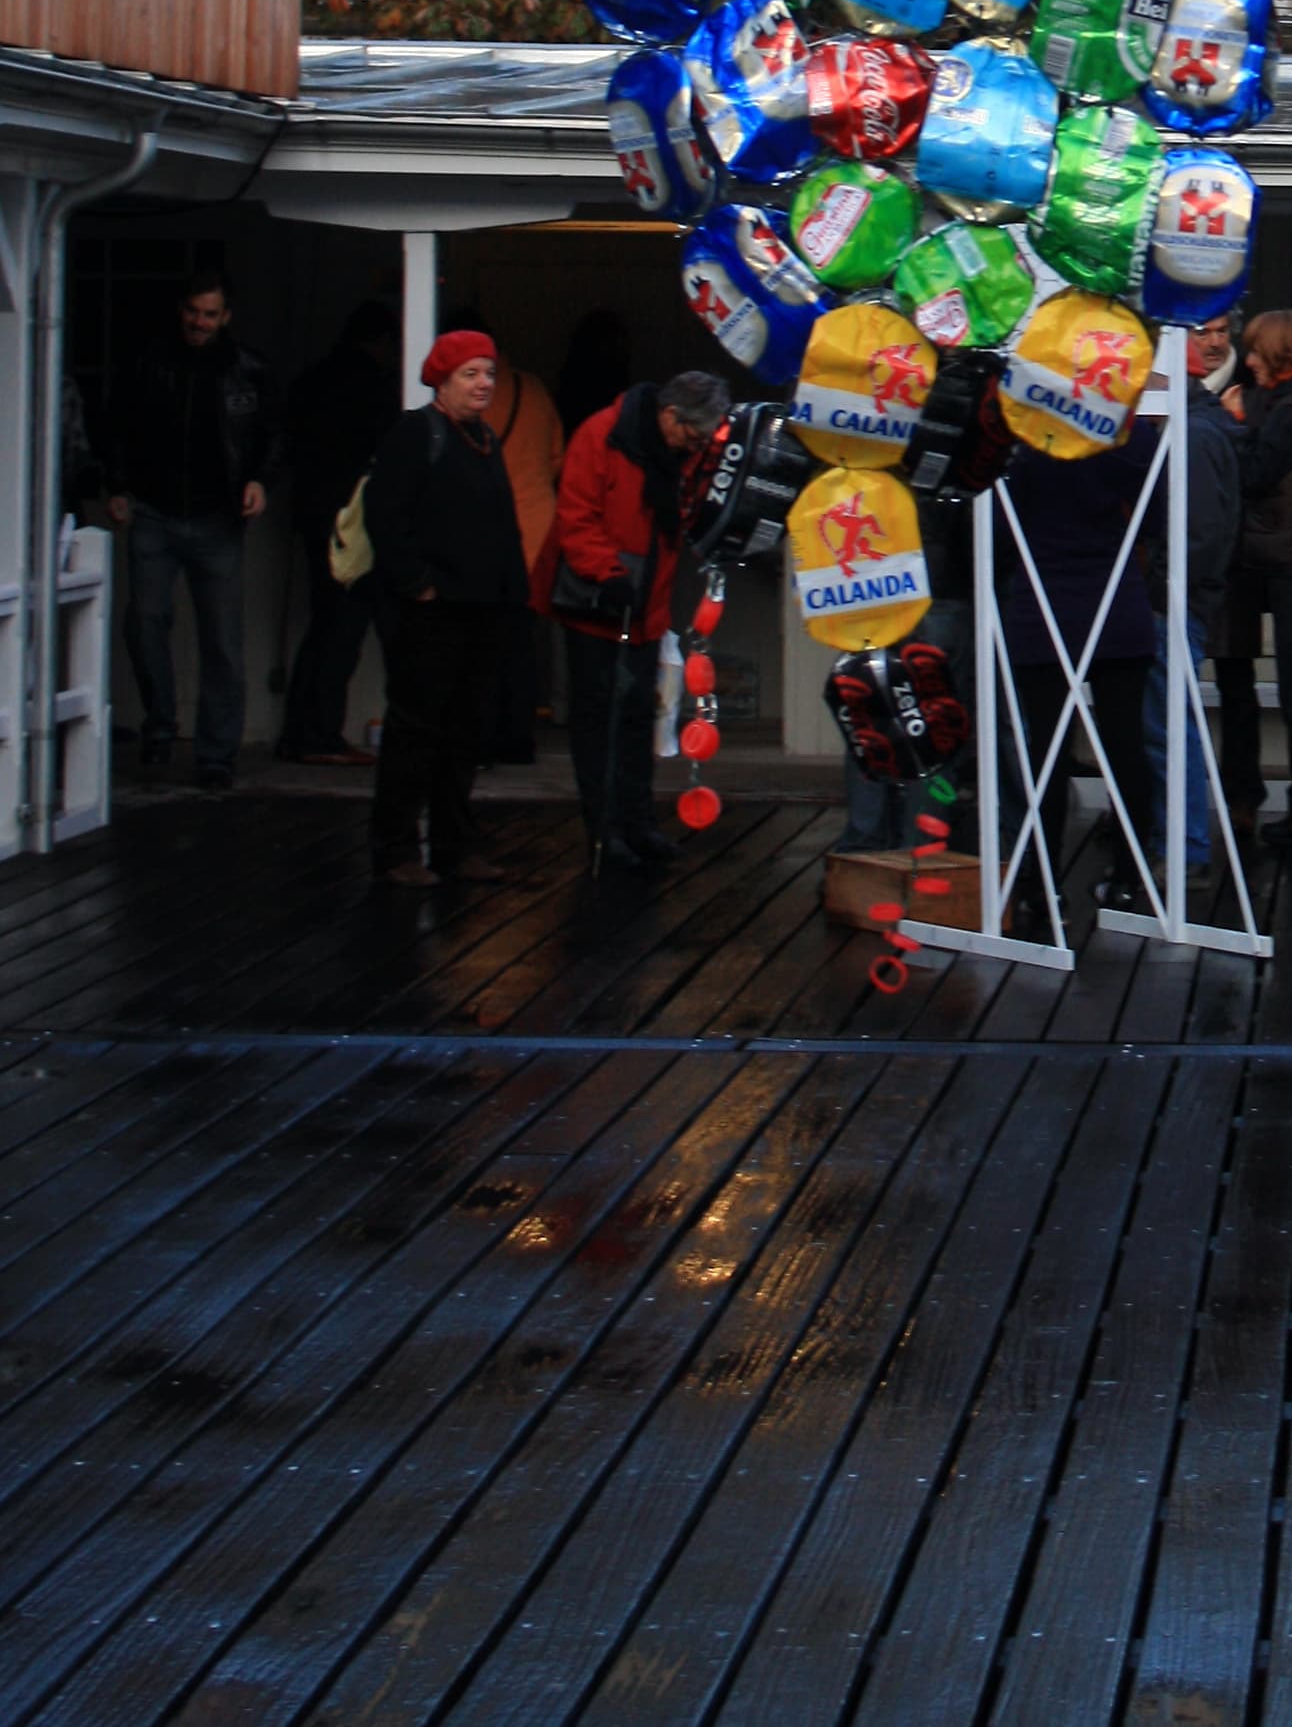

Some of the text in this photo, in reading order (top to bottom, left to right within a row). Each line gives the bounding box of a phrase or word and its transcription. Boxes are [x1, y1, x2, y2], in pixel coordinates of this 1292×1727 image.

[857, 44, 900, 146] Coca-Cola
[1026, 382, 1118, 438] CALAND
[706, 441, 744, 506] zero
[805, 571, 917, 612] CALANDA
[891, 680, 926, 737] zero
